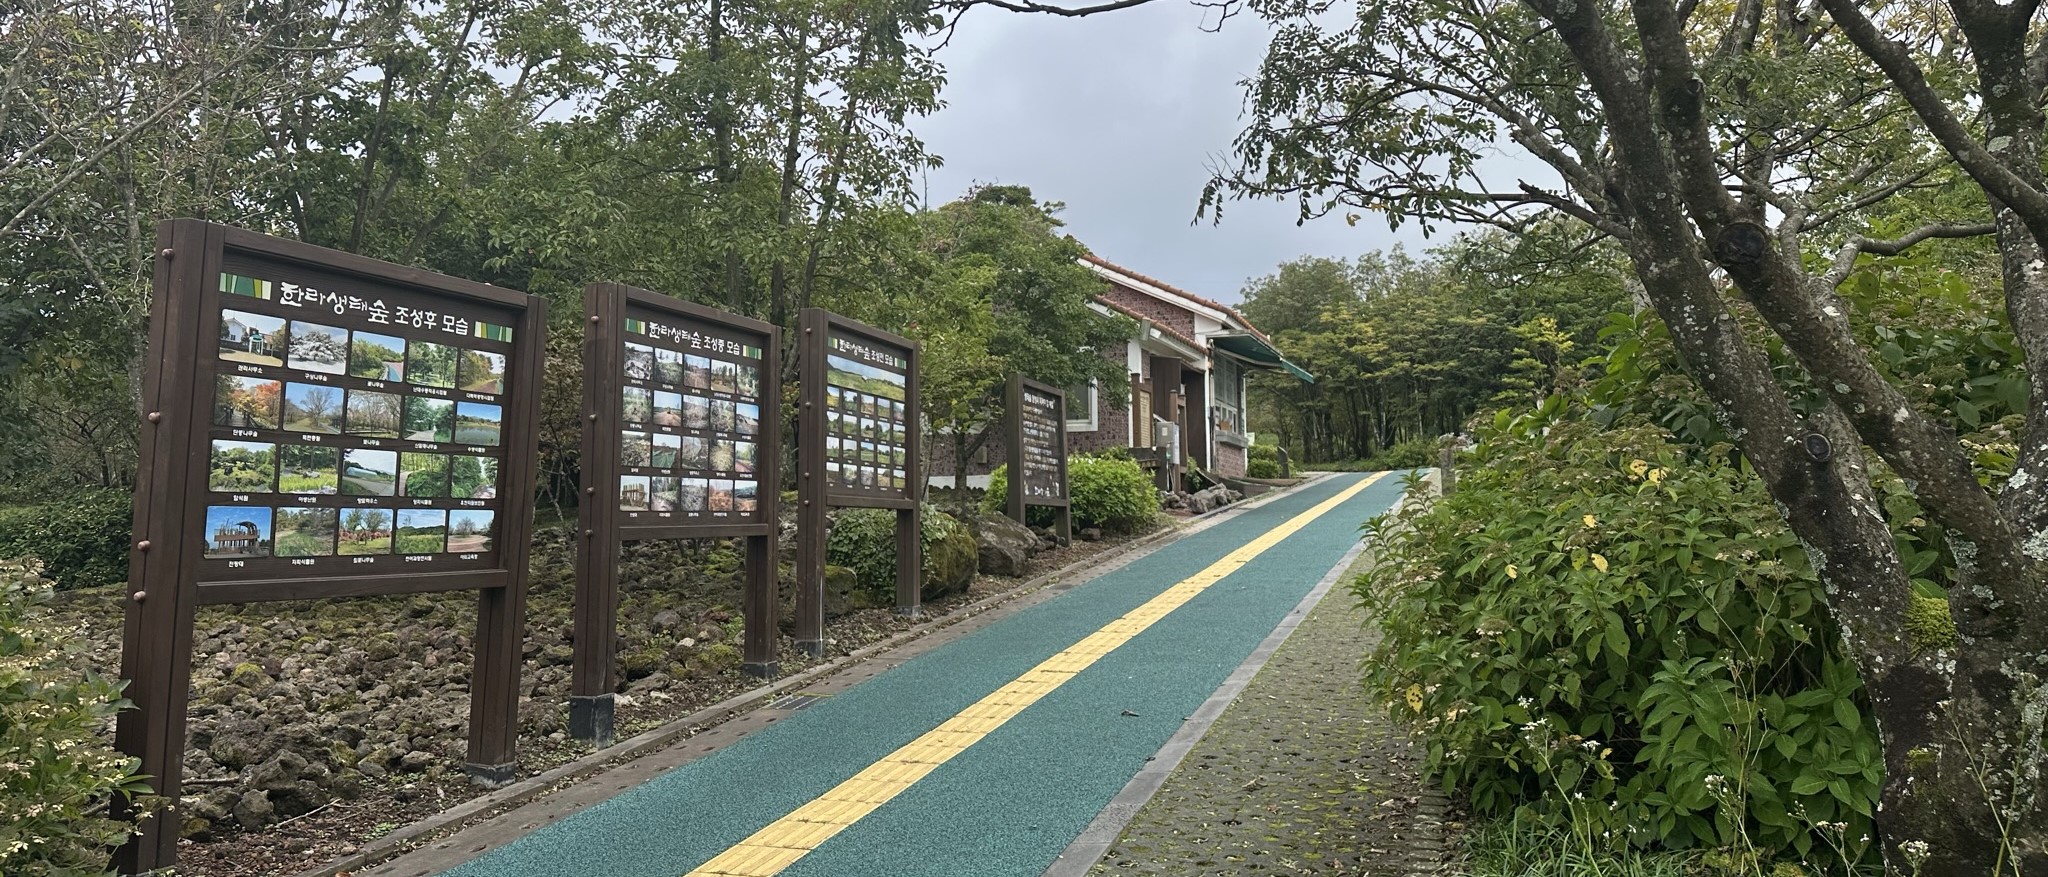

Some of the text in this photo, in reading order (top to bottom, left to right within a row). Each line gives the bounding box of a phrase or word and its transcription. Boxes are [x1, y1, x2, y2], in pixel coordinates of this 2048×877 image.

[280, 281, 469, 336] 한라생태숲 조성후 모습
[649, 321, 741, 355] 한라생태숲 조성중 모습
[237, 365, 263, 374] 관리사무소
